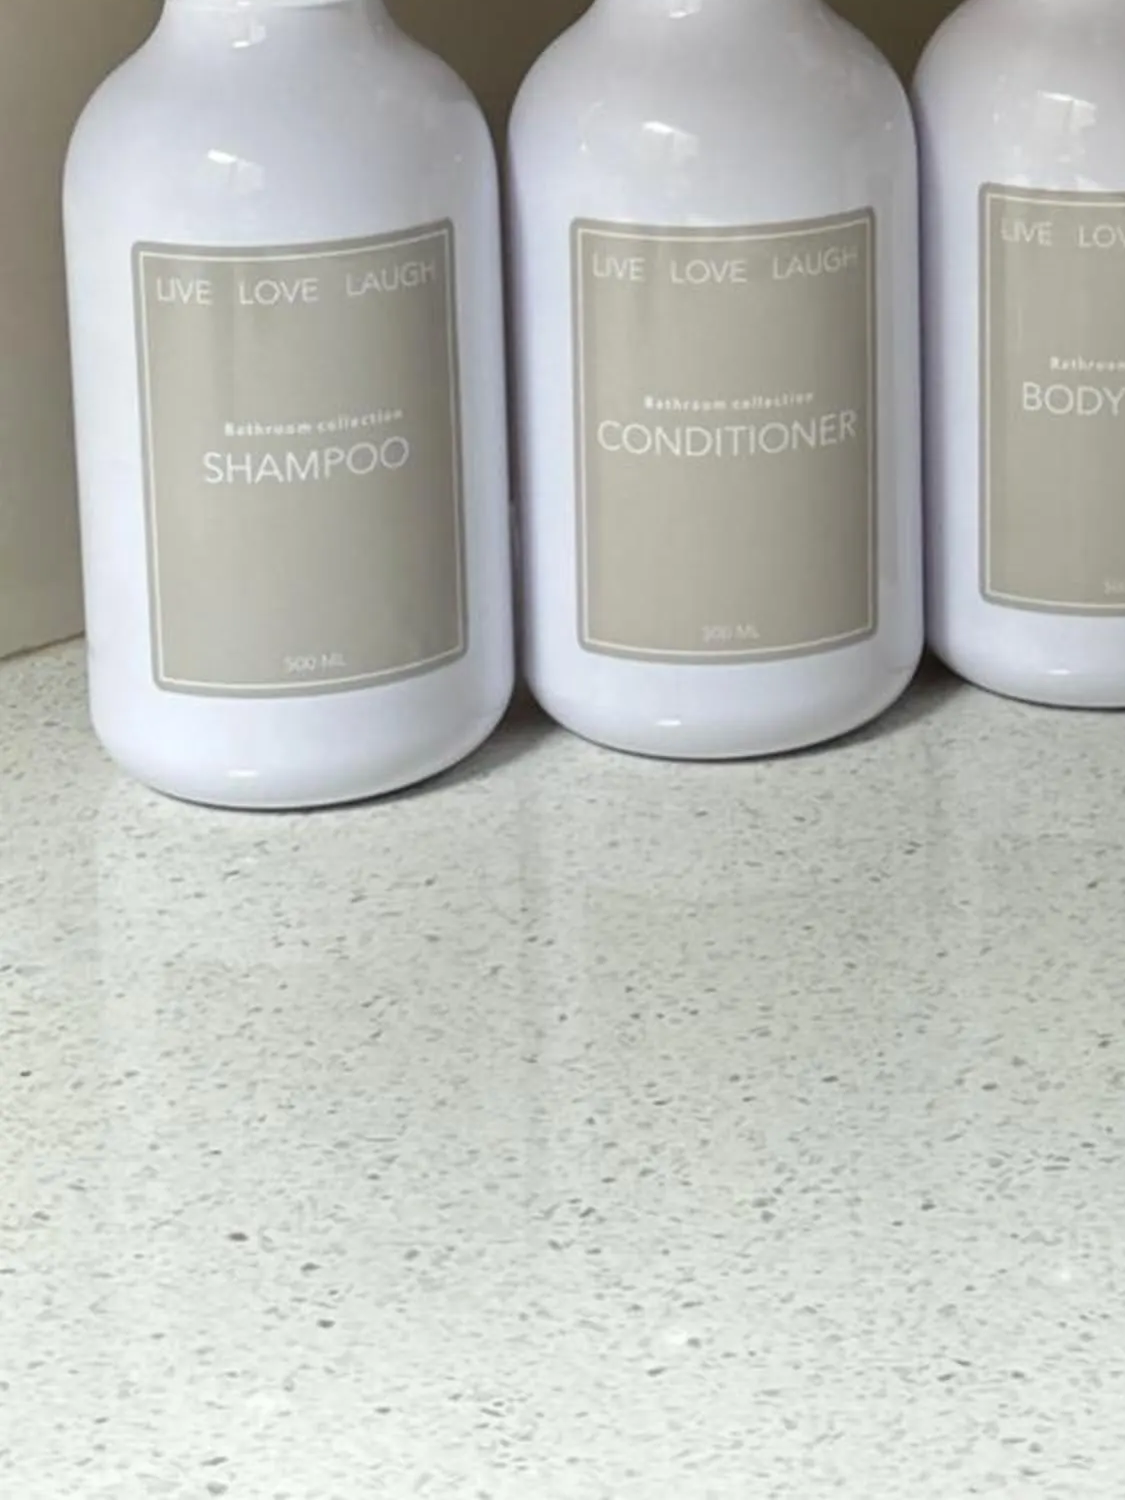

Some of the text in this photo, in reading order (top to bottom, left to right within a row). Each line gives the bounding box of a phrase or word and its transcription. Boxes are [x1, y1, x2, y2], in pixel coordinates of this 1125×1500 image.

[1000, 217, 1054, 246] LIVE
[155, 261, 438, 306] LIVE LOVE LAUGH
[591, 245, 858, 285] LIVE LOVE LAUGH
[1022, 380, 1125, 416] BODY
[596, 408, 859, 458] CONDITIONER
[202, 435, 412, 485] SHAMPOO
